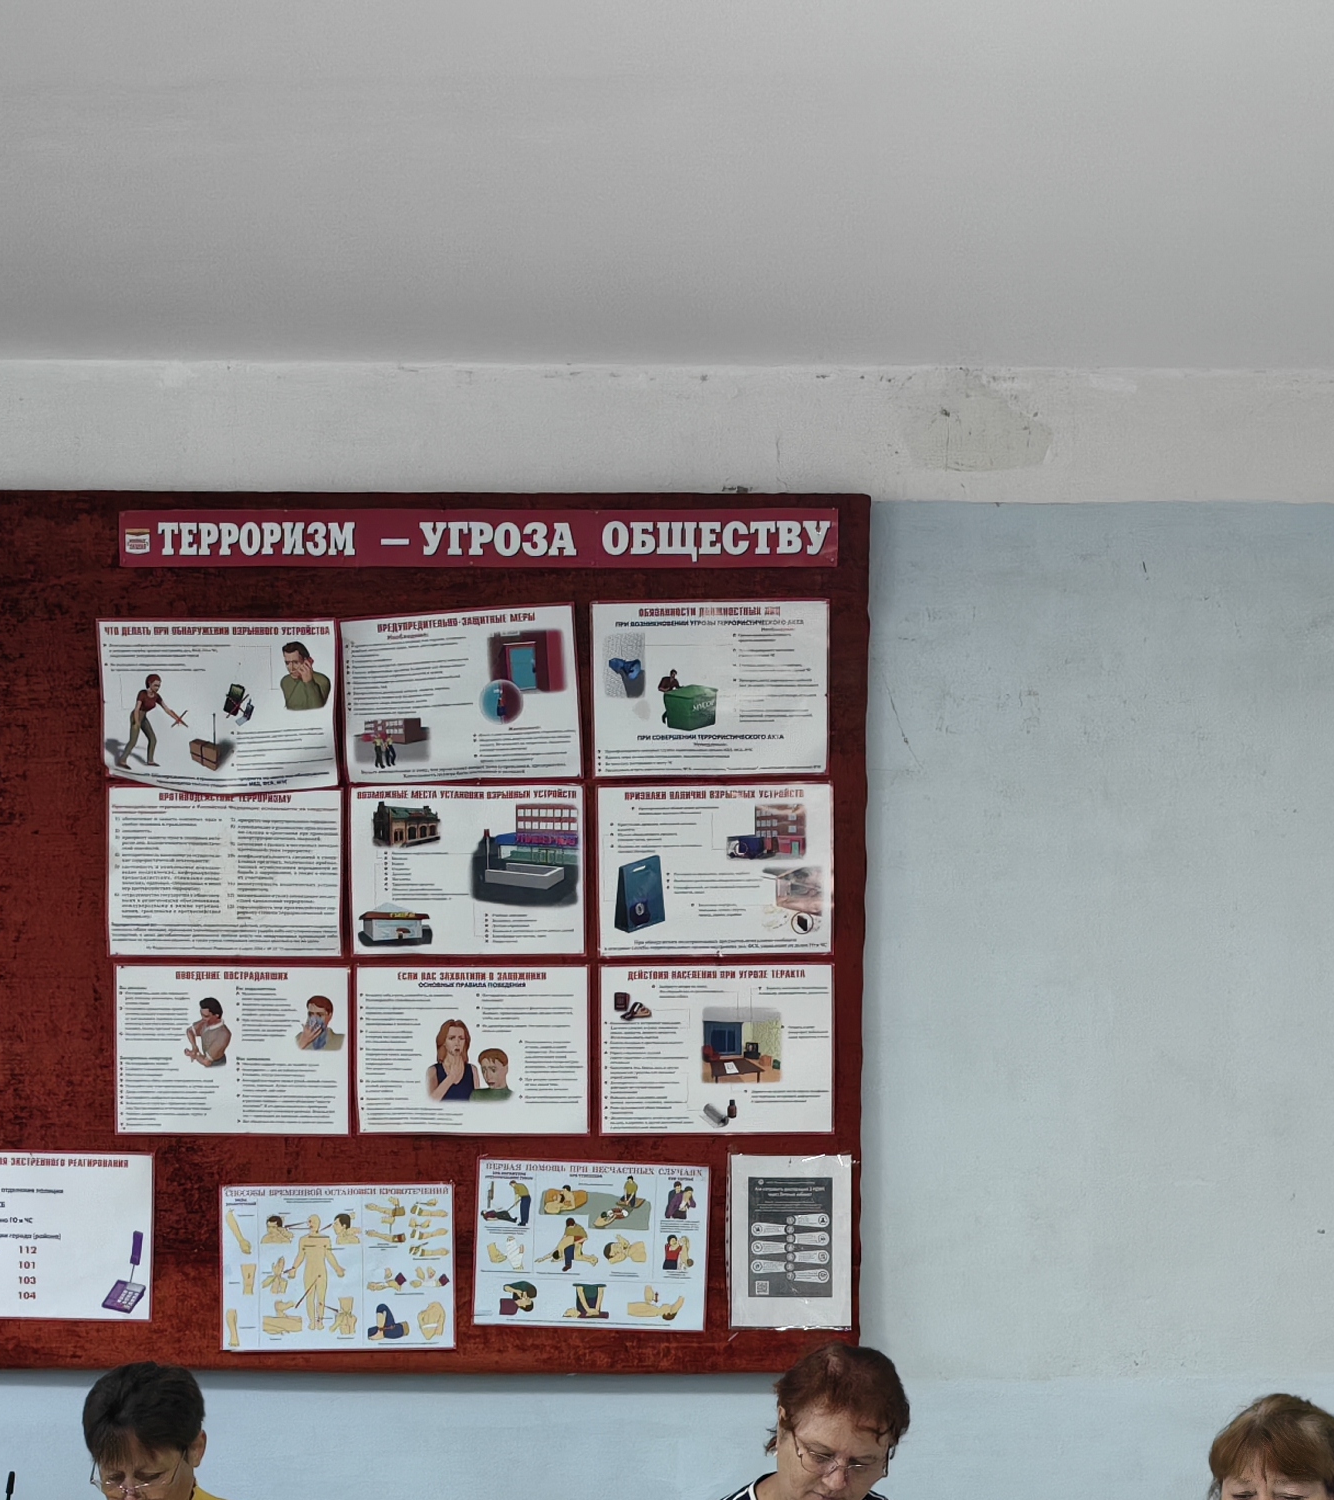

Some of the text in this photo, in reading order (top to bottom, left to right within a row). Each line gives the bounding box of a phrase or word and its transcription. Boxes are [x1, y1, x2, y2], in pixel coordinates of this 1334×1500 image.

[158, 521, 355, 556] ТЕРРОРИЗМ
[419, 521, 577, 556] УГРОЗА
[602, 520, 831, 562] ОБЩЕСТВУ
[510, 612, 535, 622] МЕРЫ
[639, 607, 696, 617] ОБЯЗАННОСТИ
[104, 625, 330, 636] ЧТО ДЕЛАТЬ ПРИ ОБНАРУЖЕНИИ ВЗРЫВНОГО УСТРОЙСТВА
[239, 793, 292, 803] ТЕРРОРИЗМУ
[357, 788, 577, 800] ВОЗМОЖНЫЕ МЕСТА УСТАНОВКИ ВЗРЫВНЫХ УСТРОЙСТВ
[624, 791, 666, 800] ПРИЗНАКИ
[670, 790, 706, 800] НАЛИЧИЯ
[759, 788, 804, 798] УСТРОЙСТВ
[175, 971, 288, 981] ПОВЕДЕНИЕ ПОСТРАДАВШИХ
[397, 971, 418, 980] ЕСЛИ
[421, 972, 437, 980] ВАС
[439, 971, 486, 980] ЗАХВАТИЛИ
[497, 971, 546, 981] ЗАЛОЖНИКИ
[627, 968, 805, 981] ДЕЙСТВИЯ НАСЕЛЕНИЯ ПРИ УГРОЗЕ ТЕРАКТА
[11, 1157, 65, 1166] ЭКСТРЕННОГО
[68, 1158, 128, 1168] РЕАГИРОВАНИЯ
[486, 1162, 702, 1176] ПЕРВАЯ ПОМОЩЬ ПРИ НЕСЧАСТНЫХ СЛУЧАЯХ
[324, 1188, 377, 1196] ОСТАНОВКИ
[19, 1246, 37, 1254] 112
[19, 1261, 36, 1269] 101
[18, 1276, 36, 1284] 103
[18, 1291, 36, 1299] 104
